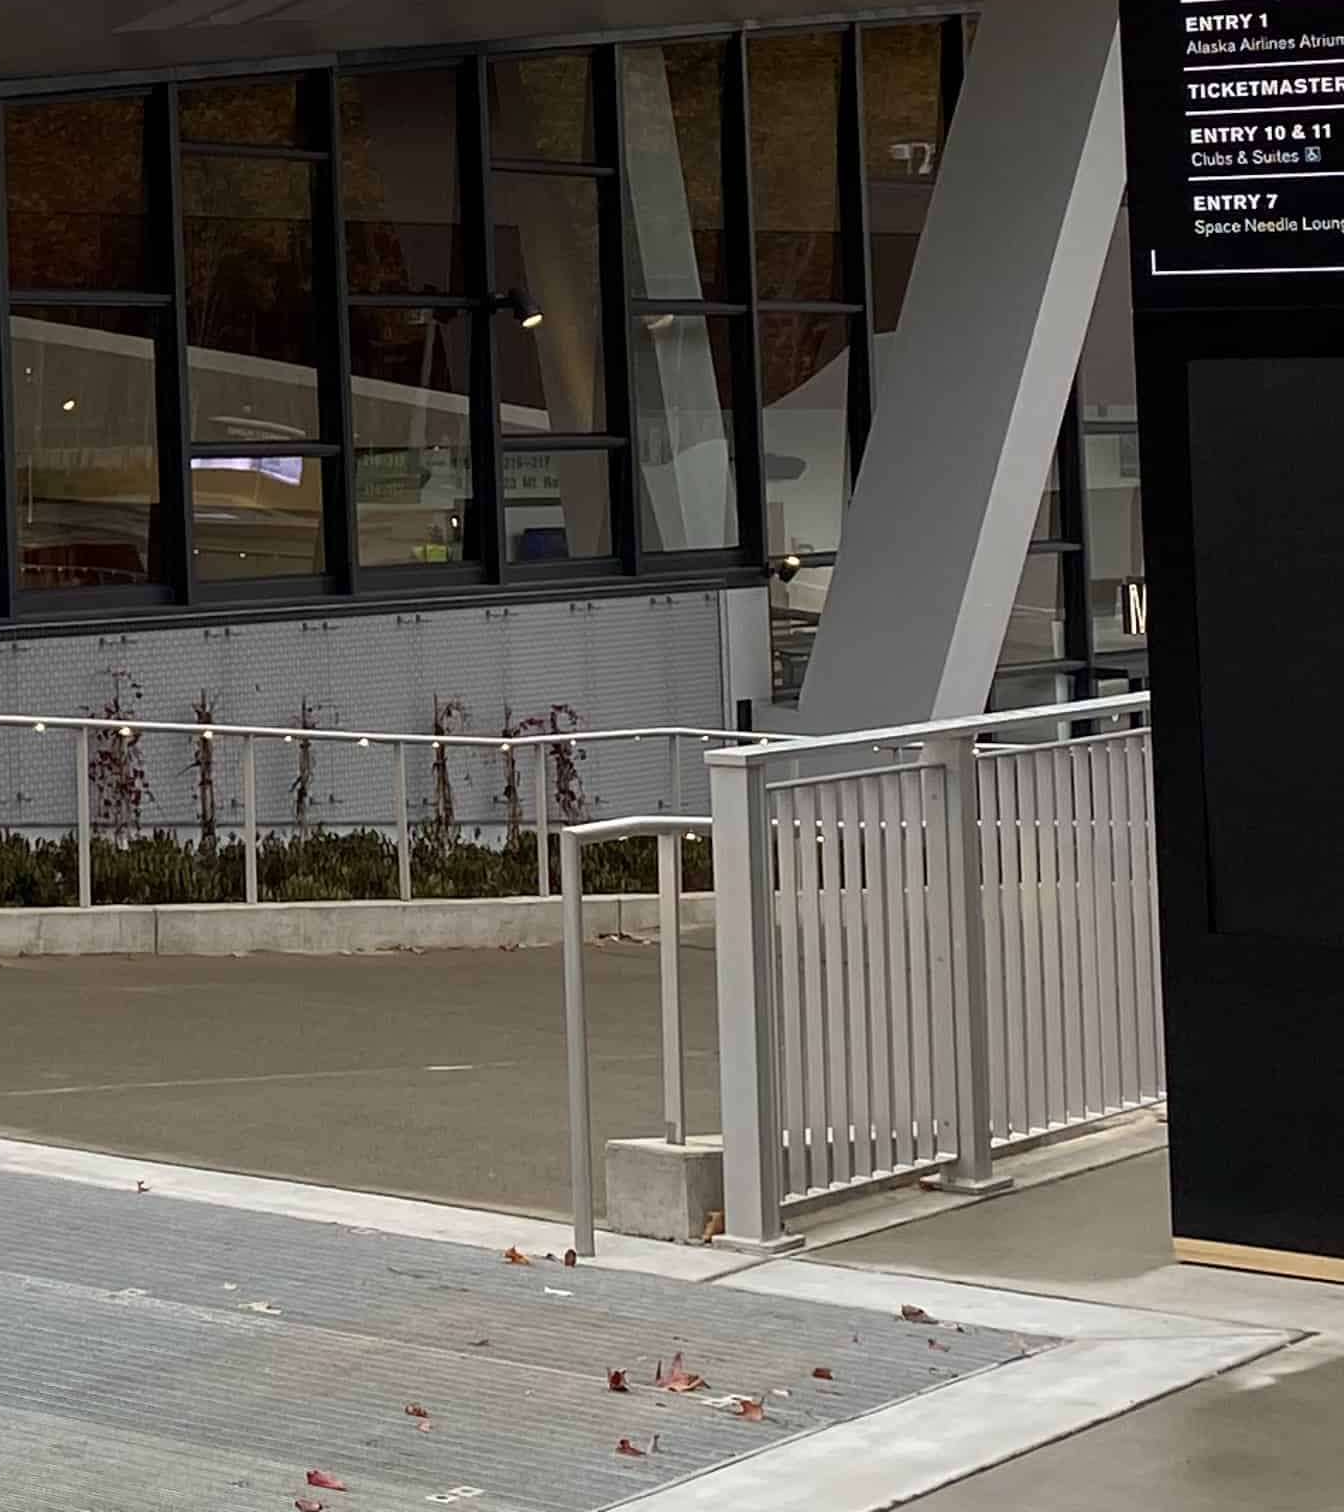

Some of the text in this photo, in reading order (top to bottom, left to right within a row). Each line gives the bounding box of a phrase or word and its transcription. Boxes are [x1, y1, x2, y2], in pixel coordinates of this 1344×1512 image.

[1185, 13, 1268, 32] ENTRY 1
[1186, 39, 1237, 55] Alaska
[1239, 37, 1296, 51] Airlines
[1187, 76, 1344, 100] TICKETMASTER
[1190, 123, 1332, 144] ENTRY 10 & 11
[1191, 149, 1300, 167] Clubs & Suites
[1193, 193, 1279, 211] ENTRY 7
[1194, 219, 1242, 237] Space
[1244, 217, 1298, 232] Needle
